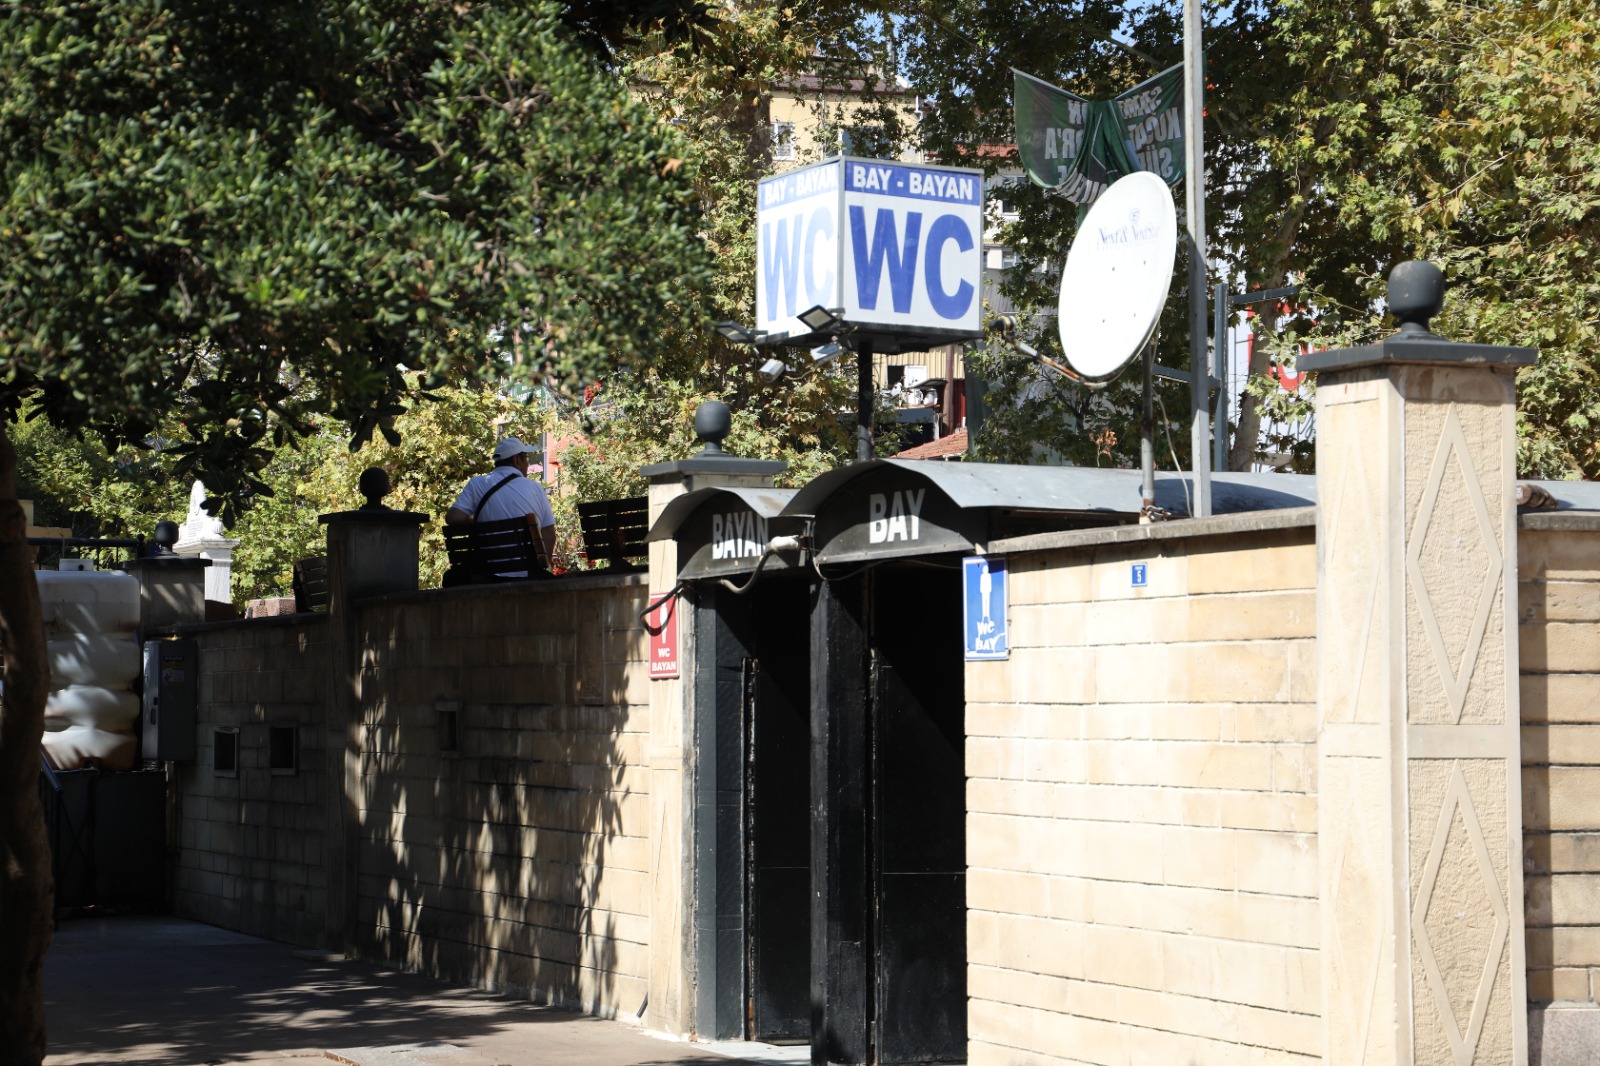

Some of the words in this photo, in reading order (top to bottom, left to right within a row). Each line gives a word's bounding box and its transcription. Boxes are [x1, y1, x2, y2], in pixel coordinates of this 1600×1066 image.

[764, 179, 787, 206] BAY
[796, 166, 839, 197] BAYAN
[853, 165, 892, 191] BAY
[909, 171, 973, 200] BAYAN
[762, 206, 835, 323] WC
[848, 204, 975, 321] WC
[711, 510, 768, 560] BAYAN
[869, 488, 926, 545] BAY
[975, 636, 998, 652] BAY
[976, 620, 995, 635] WC
[651, 661, 677, 672] BAYAN
[657, 647, 671, 658] WC
